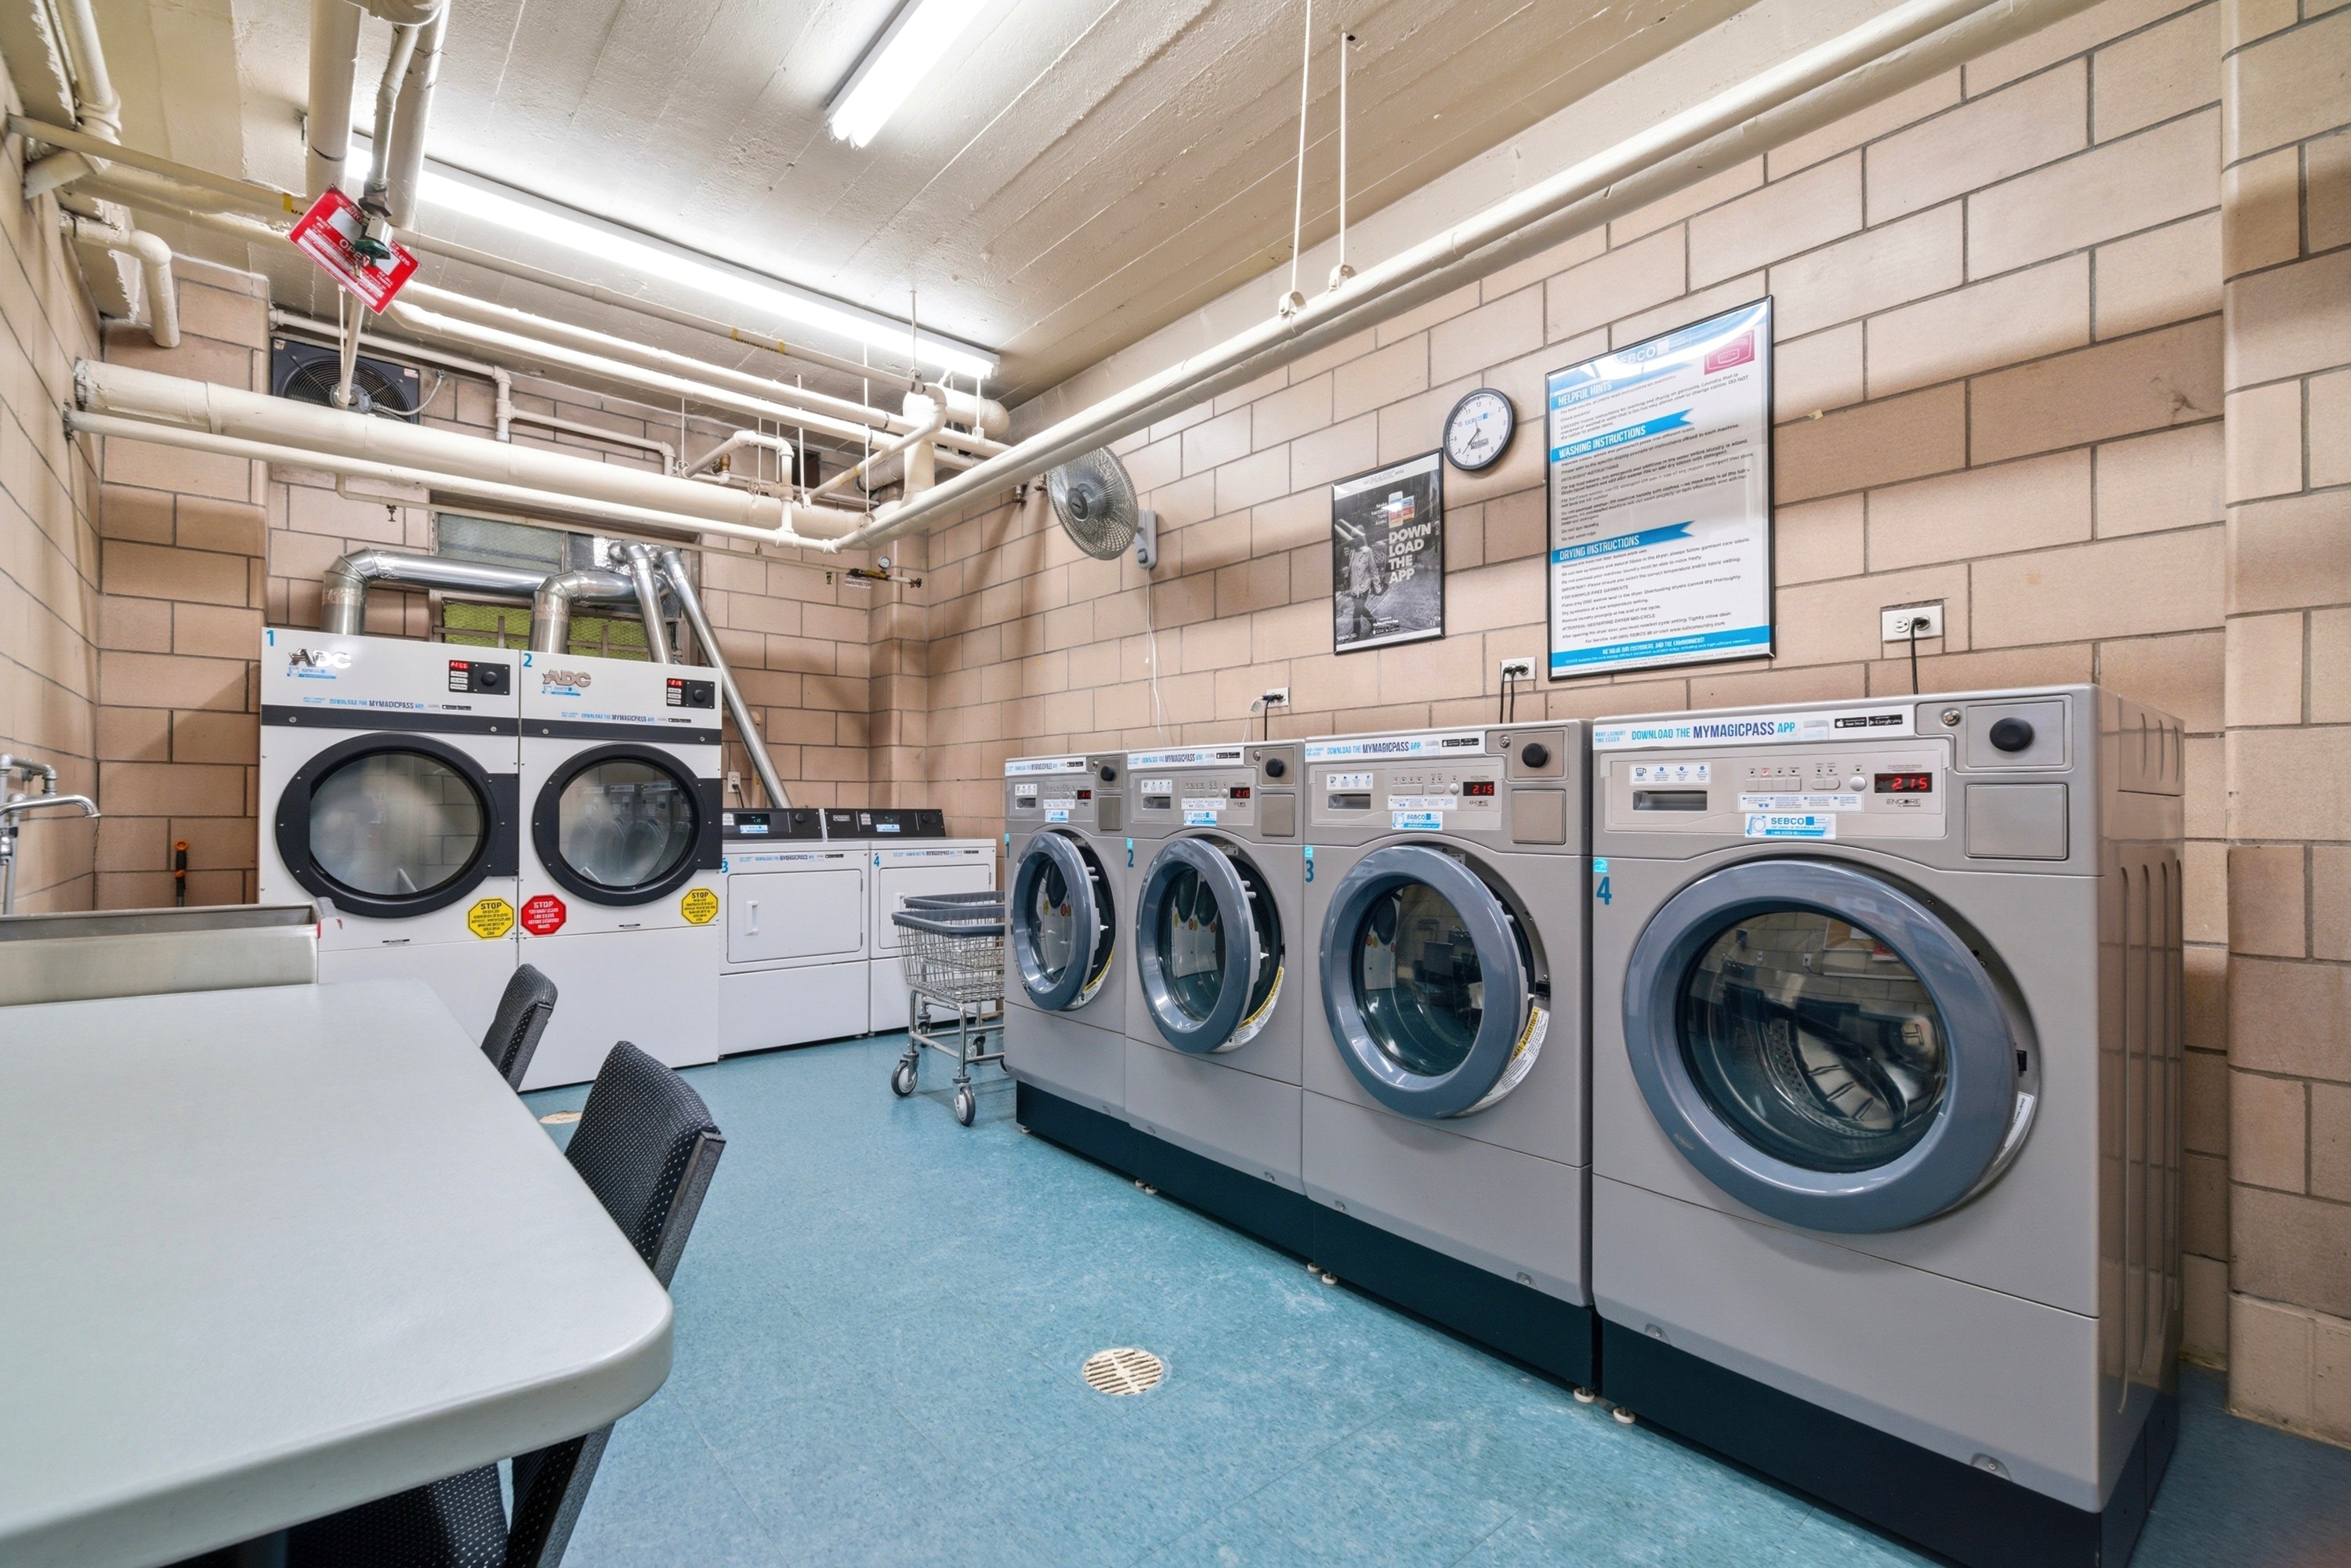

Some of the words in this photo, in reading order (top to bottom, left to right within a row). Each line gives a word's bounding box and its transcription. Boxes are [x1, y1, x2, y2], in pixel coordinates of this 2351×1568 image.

[1558, 387, 1589, 407] HELPFUL
[1589, 378, 1612, 396] HINTS
[1558, 440, 1592, 460] WASHING
[1592, 422, 1646, 449] INSTRUCTIONS
[1388, 522, 1432, 545] DOWN
[1388, 538, 1425, 558] LOAD
[1559, 545, 1585, 561] DRYING
[1585, 534, 1640, 555] INSTRUCTIONS
[1388, 555, 1413, 571] THE
[1388, 568, 1415, 585] APP
[266, 630, 275, 646] 1
[288, 647, 352, 668] ADC
[523, 653, 533, 668] 2
[542, 669, 592, 688] ADC
[368, 700, 415, 709] MYMAGICPASS
[1631, 728, 1674, 741] DOWNLOAD
[1675, 727, 1690, 738] THE
[1693, 722, 1775, 739] MYMAGICPASS
[1777, 722, 1795, 733] APP
[1327, 745, 1352, 755] DOWNLOAD
[1353, 745, 1362, 754] THE
[1362, 741, 1410, 754] MYMAGICPASS
[1770, 817, 1805, 825] SEBCO
[1005, 842, 1010, 859] 1
[1127, 849, 1134, 868] 2
[721, 859, 729, 874] 3
[873, 856, 880, 867] 4
[1304, 859, 1315, 883] 3
[1596, 876, 1612, 905] 4
[480, 902, 502, 911] STOP
[534, 900, 554, 909] STOP
